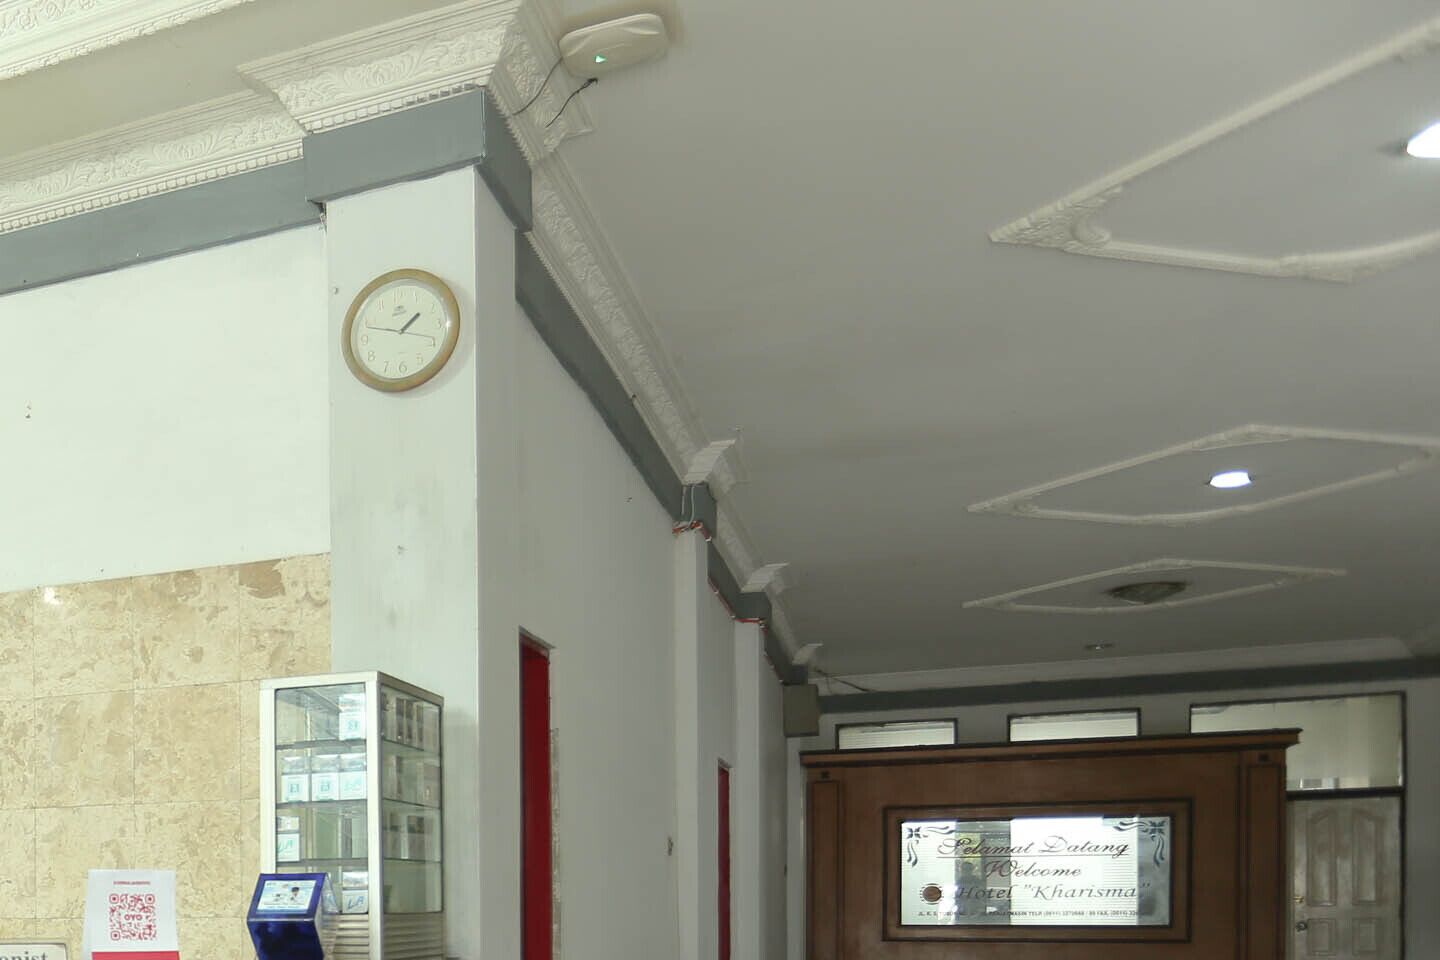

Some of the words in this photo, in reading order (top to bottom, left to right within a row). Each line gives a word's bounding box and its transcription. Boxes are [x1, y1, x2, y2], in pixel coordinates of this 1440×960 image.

[937, 838, 1034, 855] Selamat
[1038, 835, 1129, 859] Datang
[984, 860, 1081, 878] Welcome
[957, 886, 1016, 899] Hotel
